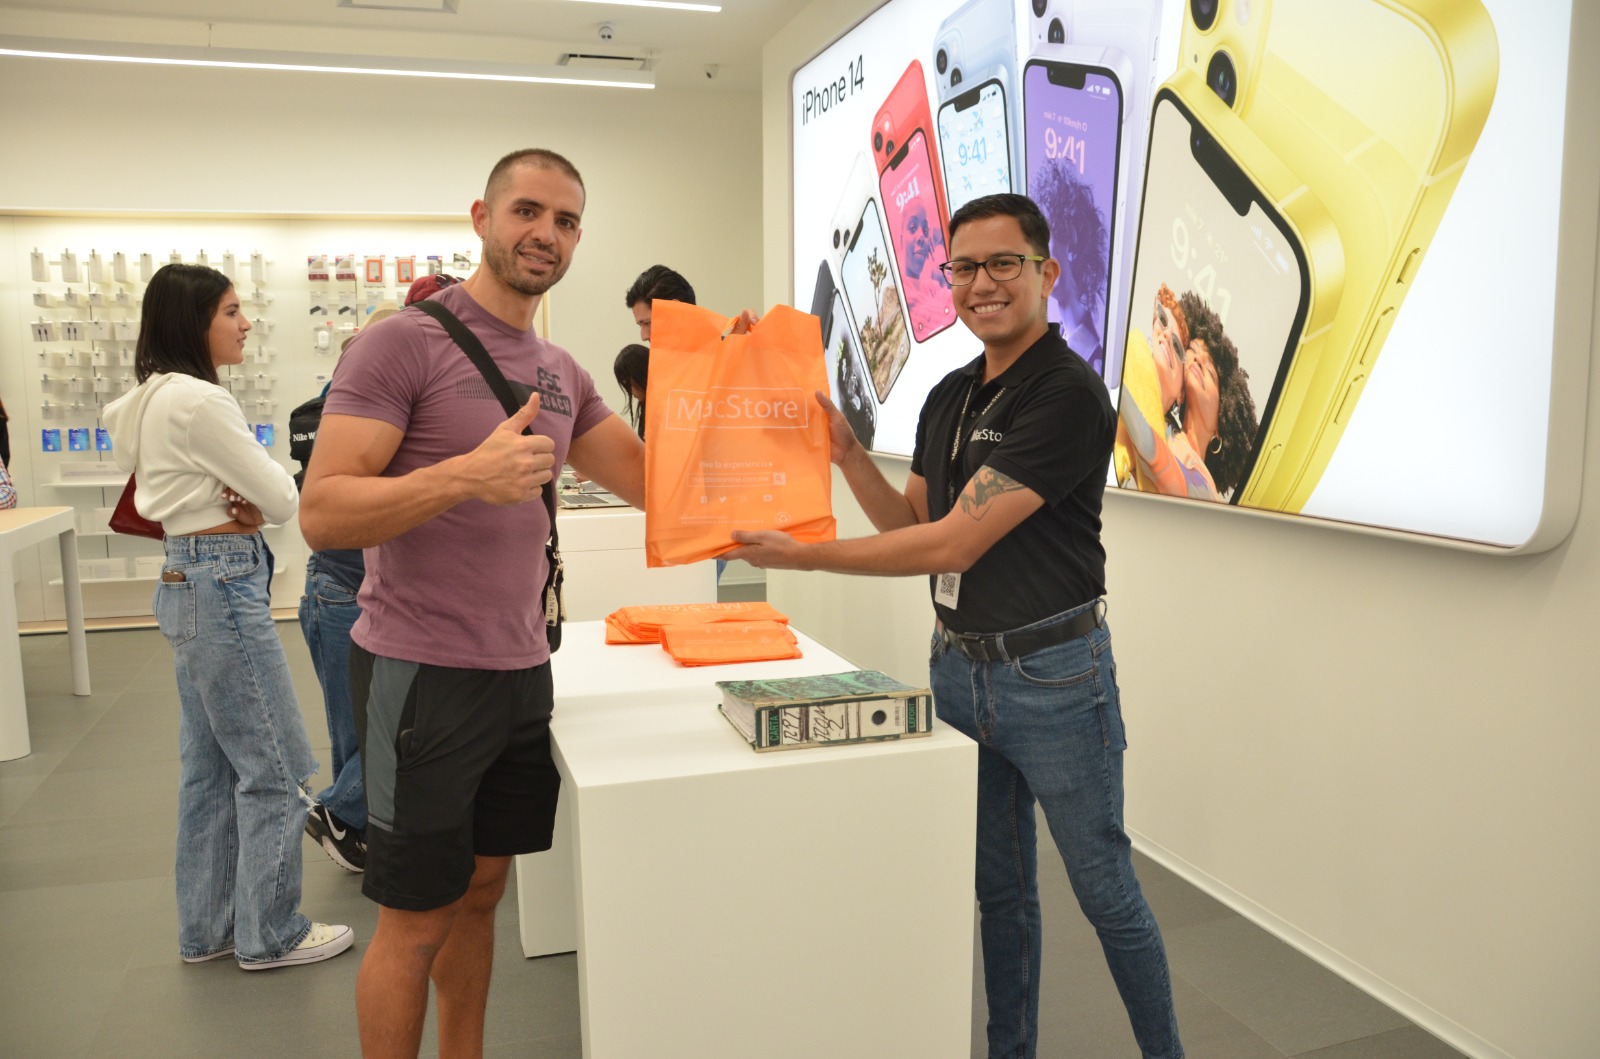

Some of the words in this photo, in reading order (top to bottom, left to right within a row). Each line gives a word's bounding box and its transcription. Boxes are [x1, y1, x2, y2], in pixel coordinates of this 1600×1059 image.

[802, 76, 846, 126] iPhone
[848, 54, 864, 96] 14
[958, 136, 987, 166] 9:41
[1045, 127, 1085, 175] 9:41
[895, 175, 920, 214] 9:41
[676, 394, 799, 421] MacStore
[292, 433, 308, 442] Nike
[769, 715, 780, 741] CARTA
